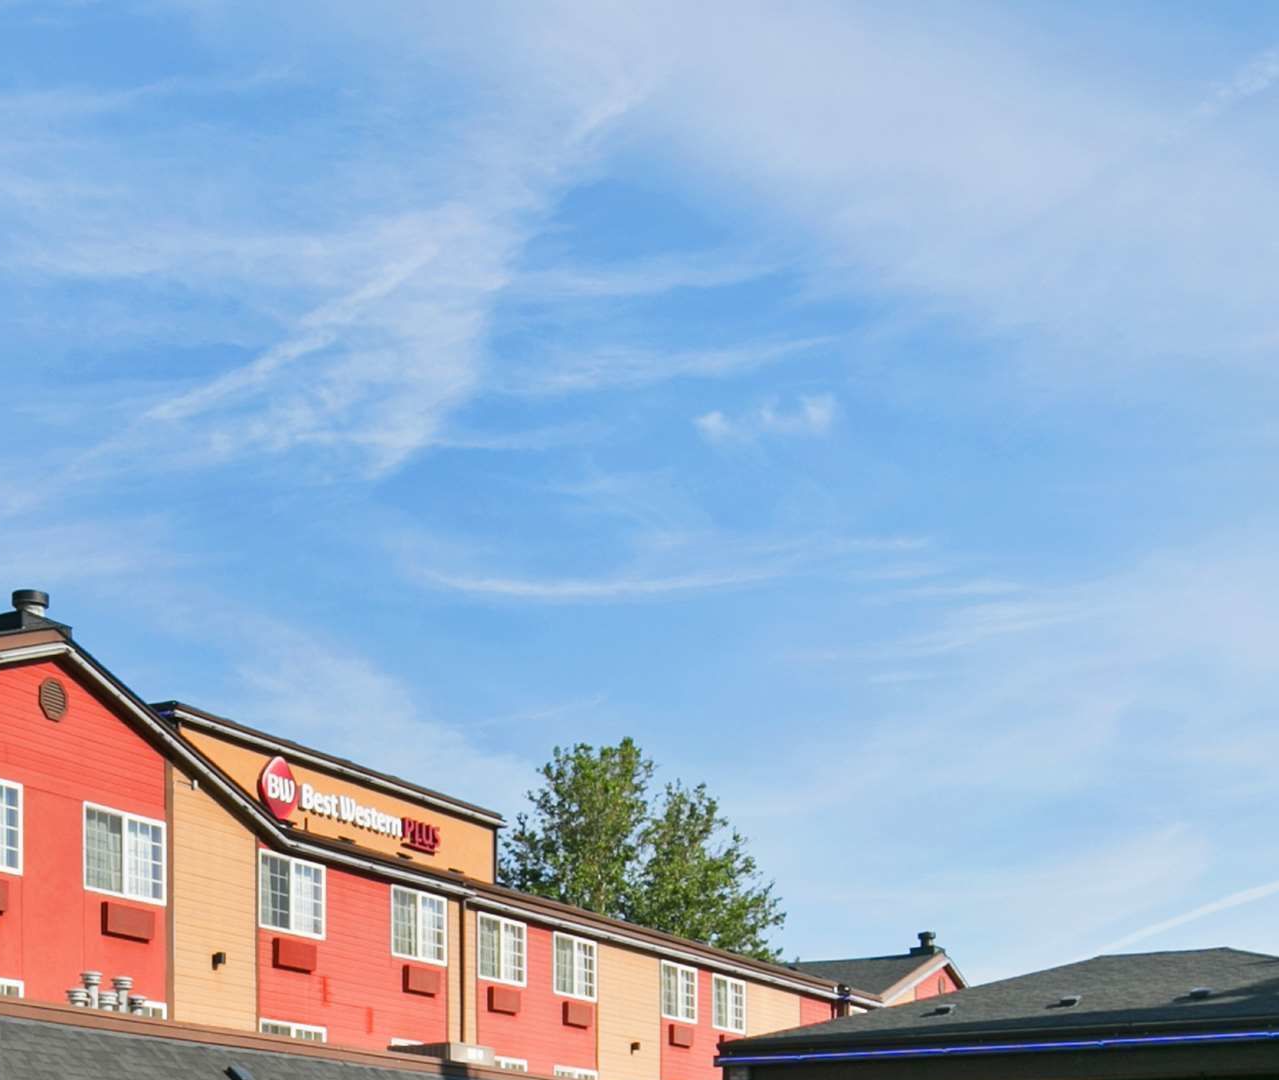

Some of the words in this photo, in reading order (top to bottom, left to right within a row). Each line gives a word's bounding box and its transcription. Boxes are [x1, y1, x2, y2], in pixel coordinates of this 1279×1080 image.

[267, 772, 296, 804] BW
[301, 783, 338, 817] Best
[338, 794, 403, 838] Western
[404, 816, 442, 850] PLUS
